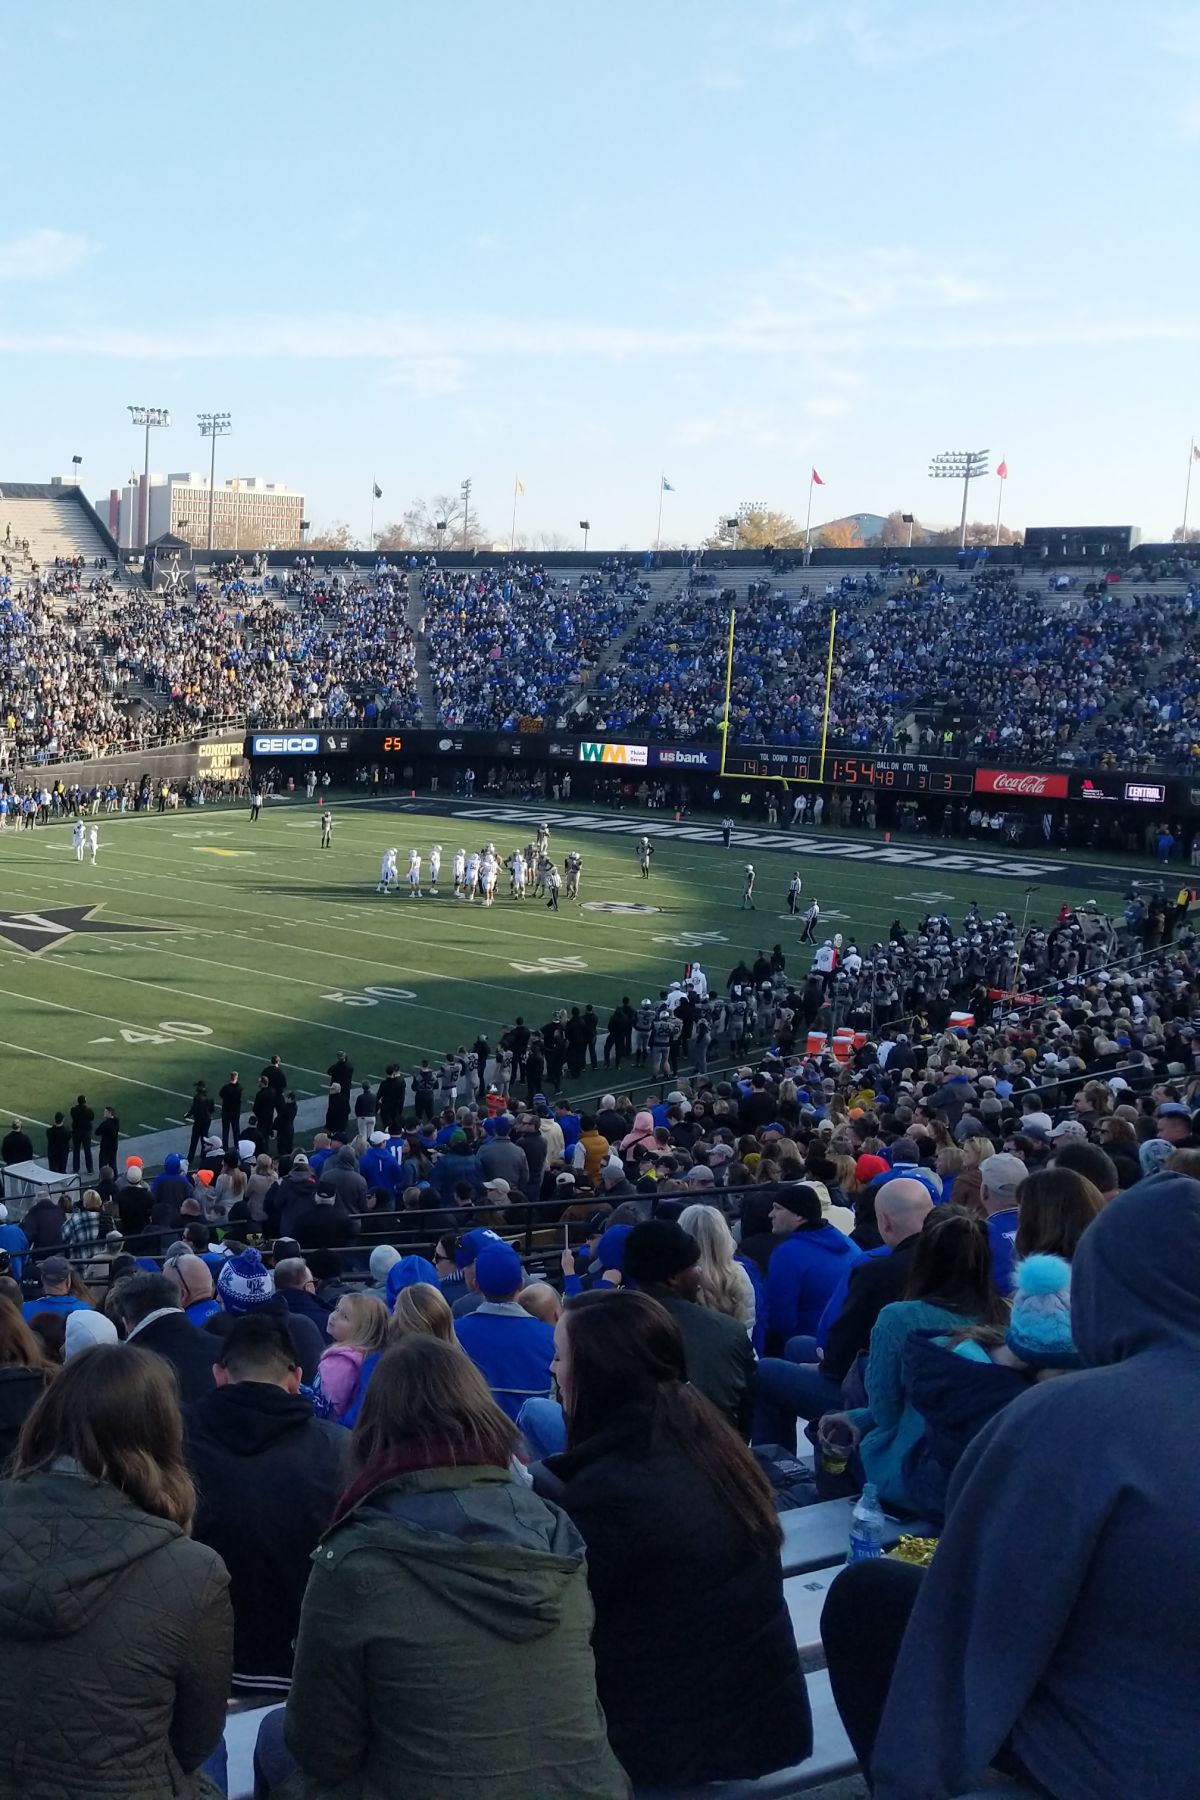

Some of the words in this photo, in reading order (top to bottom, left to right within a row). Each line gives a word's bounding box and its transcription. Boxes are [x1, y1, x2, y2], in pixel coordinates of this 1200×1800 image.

[198, 742, 244, 757] CONQUER
[255, 738, 317, 752] GEICO
[384, 737, 402, 751] 25
[581, 743, 628, 763] WM
[210, 755, 232, 769] AND
[772, 754, 788, 763] DOWN
[876, 761, 890, 769] BALL
[743, 761, 756, 774] 14
[761, 765, 768, 776] 3
[794, 766, 808, 779] 10
[832, 758, 875, 784] 1:54
[875, 771, 895, 786] 48
[918, 777, 926, 788] 3
[943, 774, 953, 789] 3
[992, 773, 1048, 794] Coca-Cola
[1128, 786, 1161, 799] CENTRAL
[450, 808, 1064, 877] COMMODORES
[319, 986, 418, 1007] 50
[119, 1021, 214, 1045] 40
[390, 1145, 403, 1166] 11
